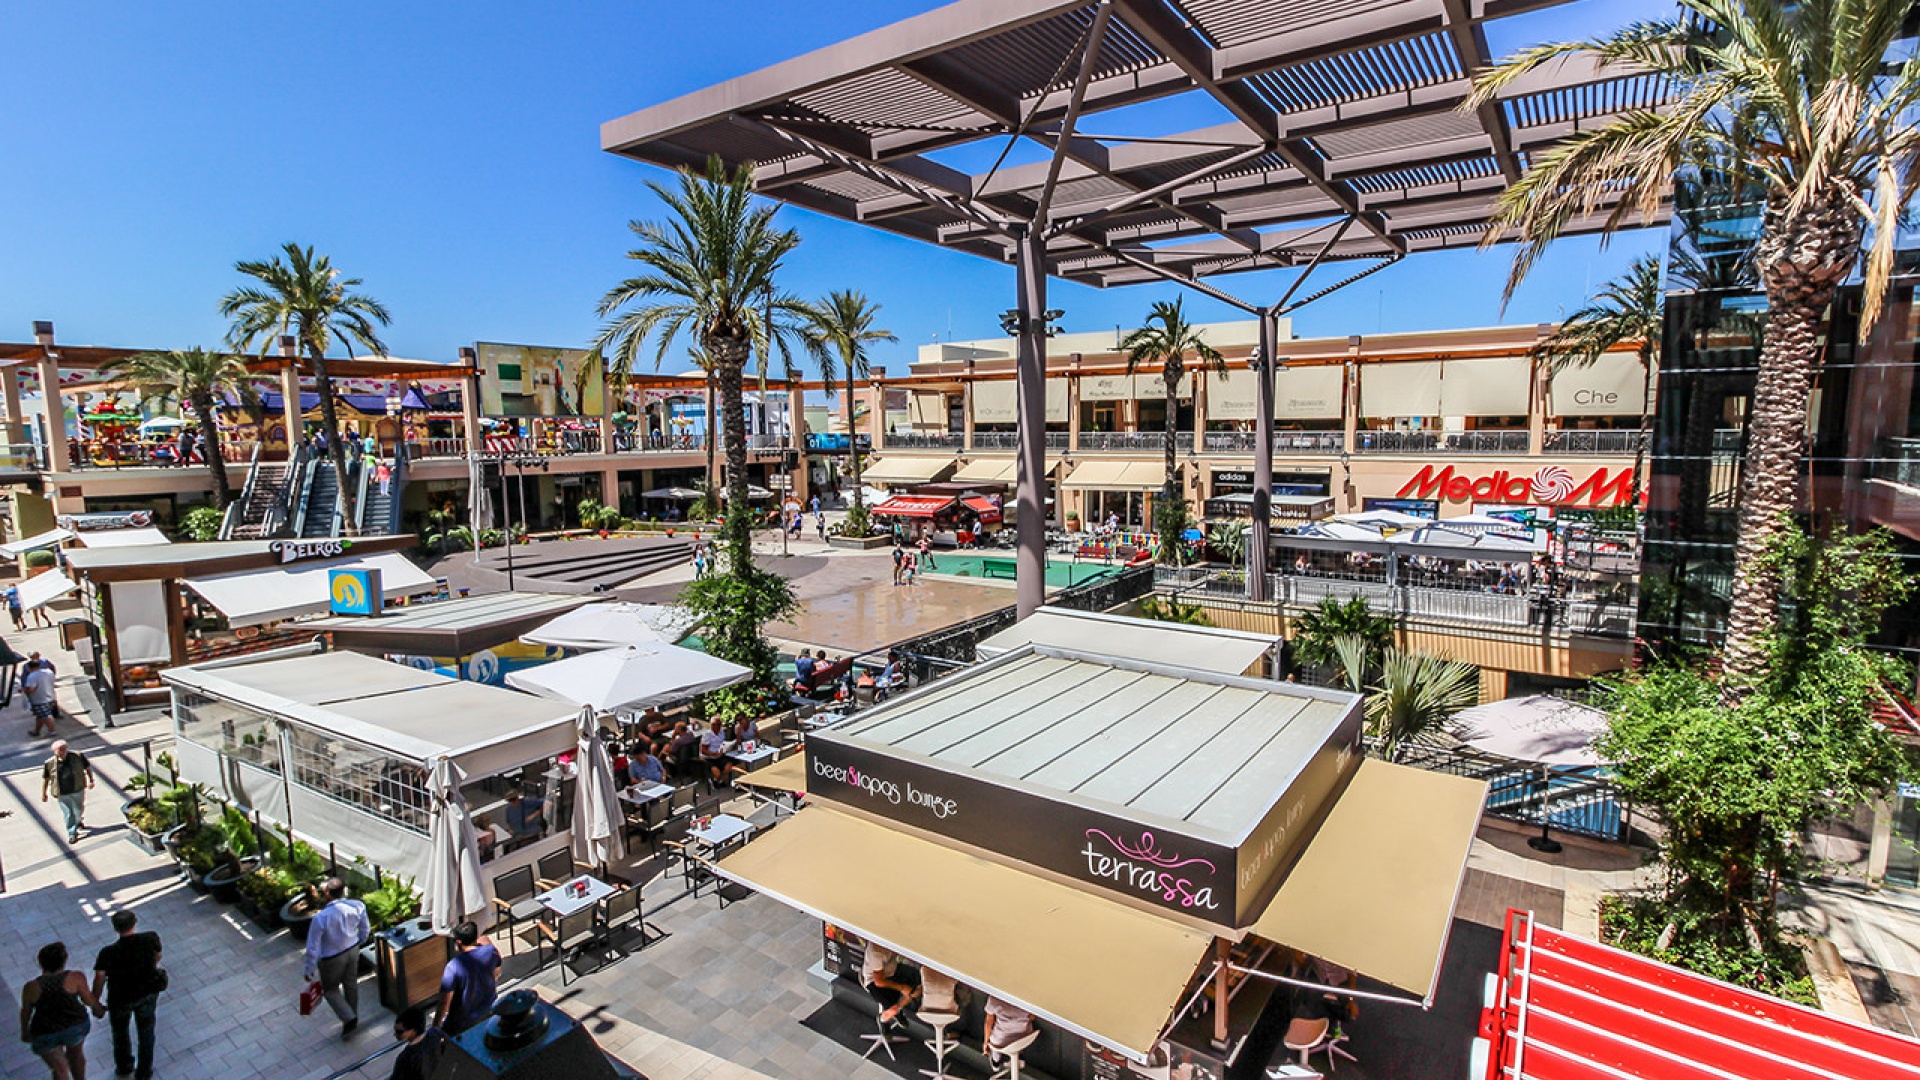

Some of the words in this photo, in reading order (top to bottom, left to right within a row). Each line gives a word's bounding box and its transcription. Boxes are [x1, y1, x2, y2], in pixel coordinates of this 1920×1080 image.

[1574, 389, 1618, 405] Che
[1219, 473, 1247, 481] adidas
[1395, 464, 1534, 502] Media
[907, 782, 958, 819] lounge
[1081, 841, 1219, 910] terrassa
